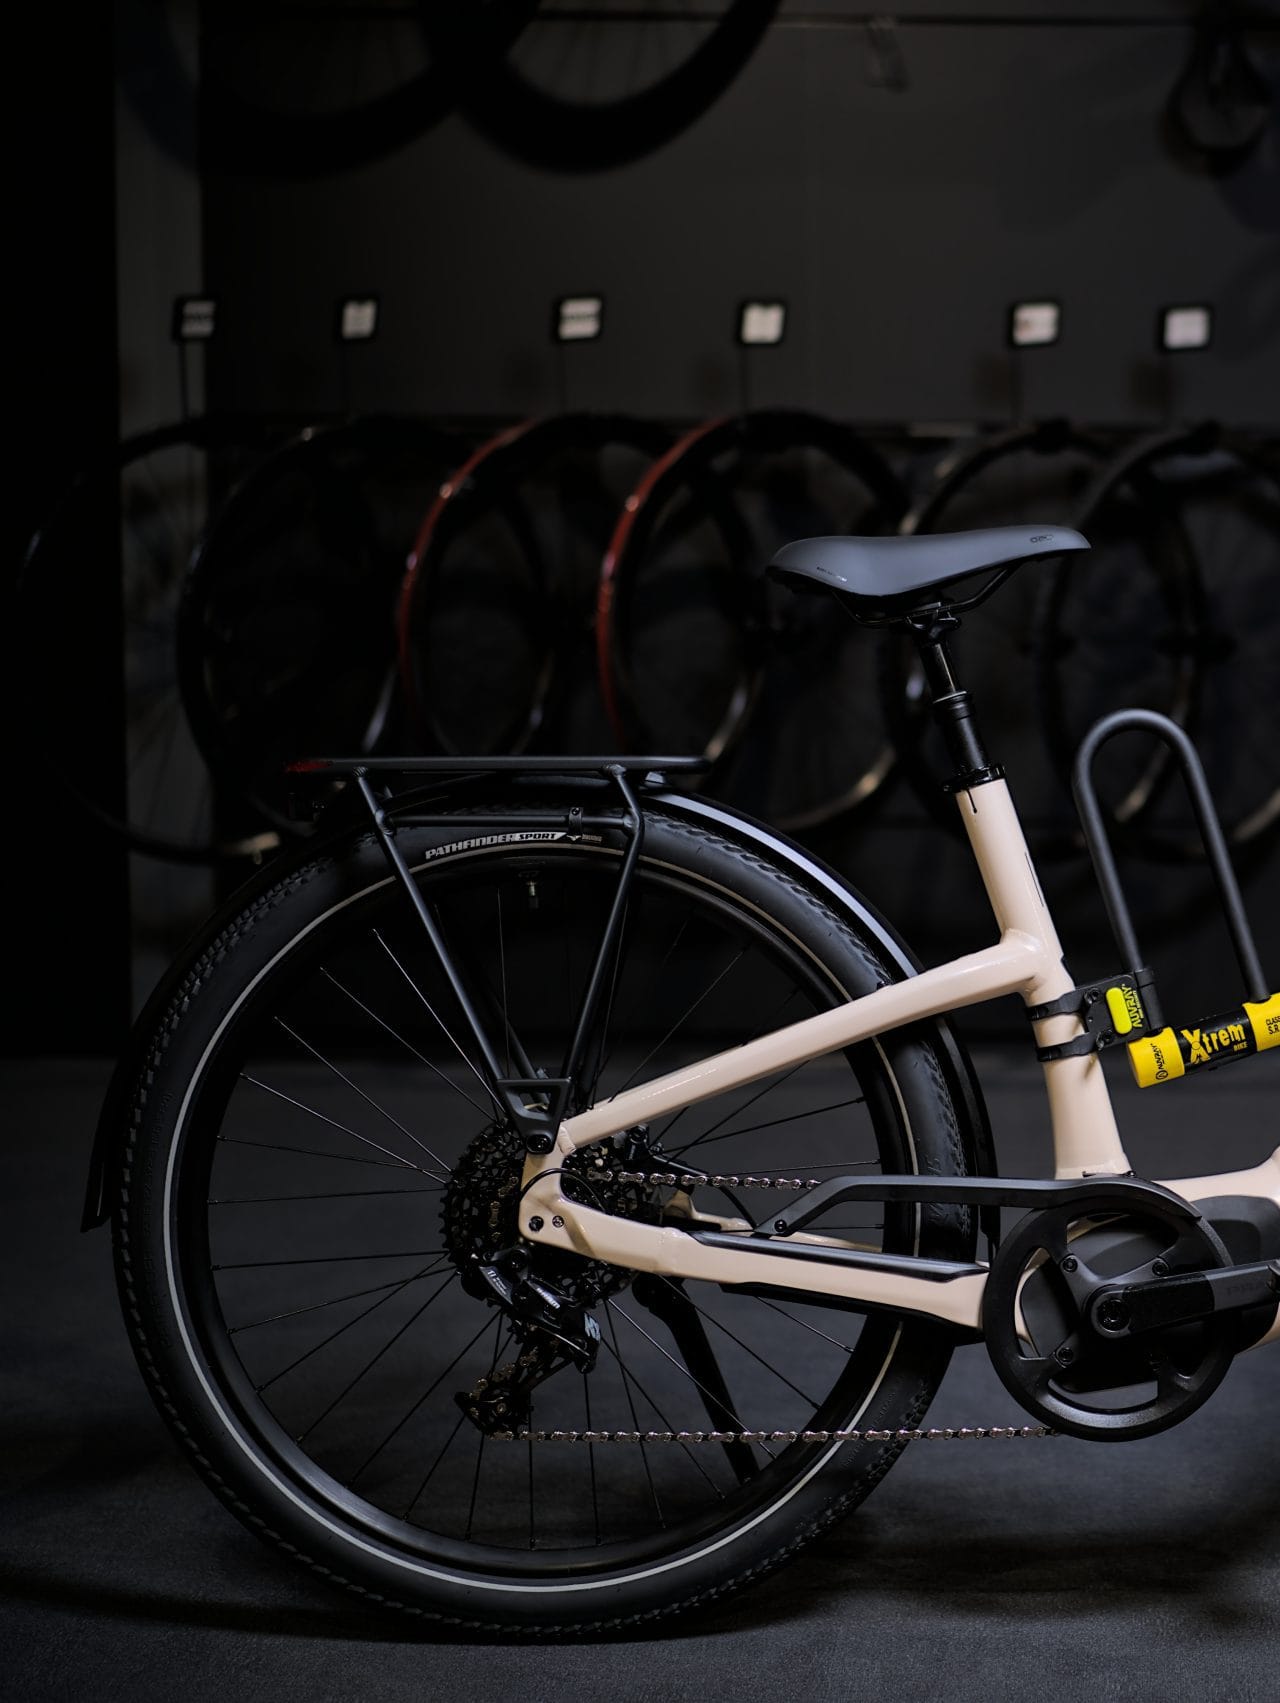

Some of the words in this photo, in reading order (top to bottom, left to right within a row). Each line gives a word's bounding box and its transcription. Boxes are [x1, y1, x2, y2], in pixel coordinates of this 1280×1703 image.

[425, 832, 514, 860] PATHFINDER
[518, 831, 557, 841] SPORT
[1122, 985, 1143, 1028] AUVRAY
[1181, 1024, 1246, 1064] Xtrem
